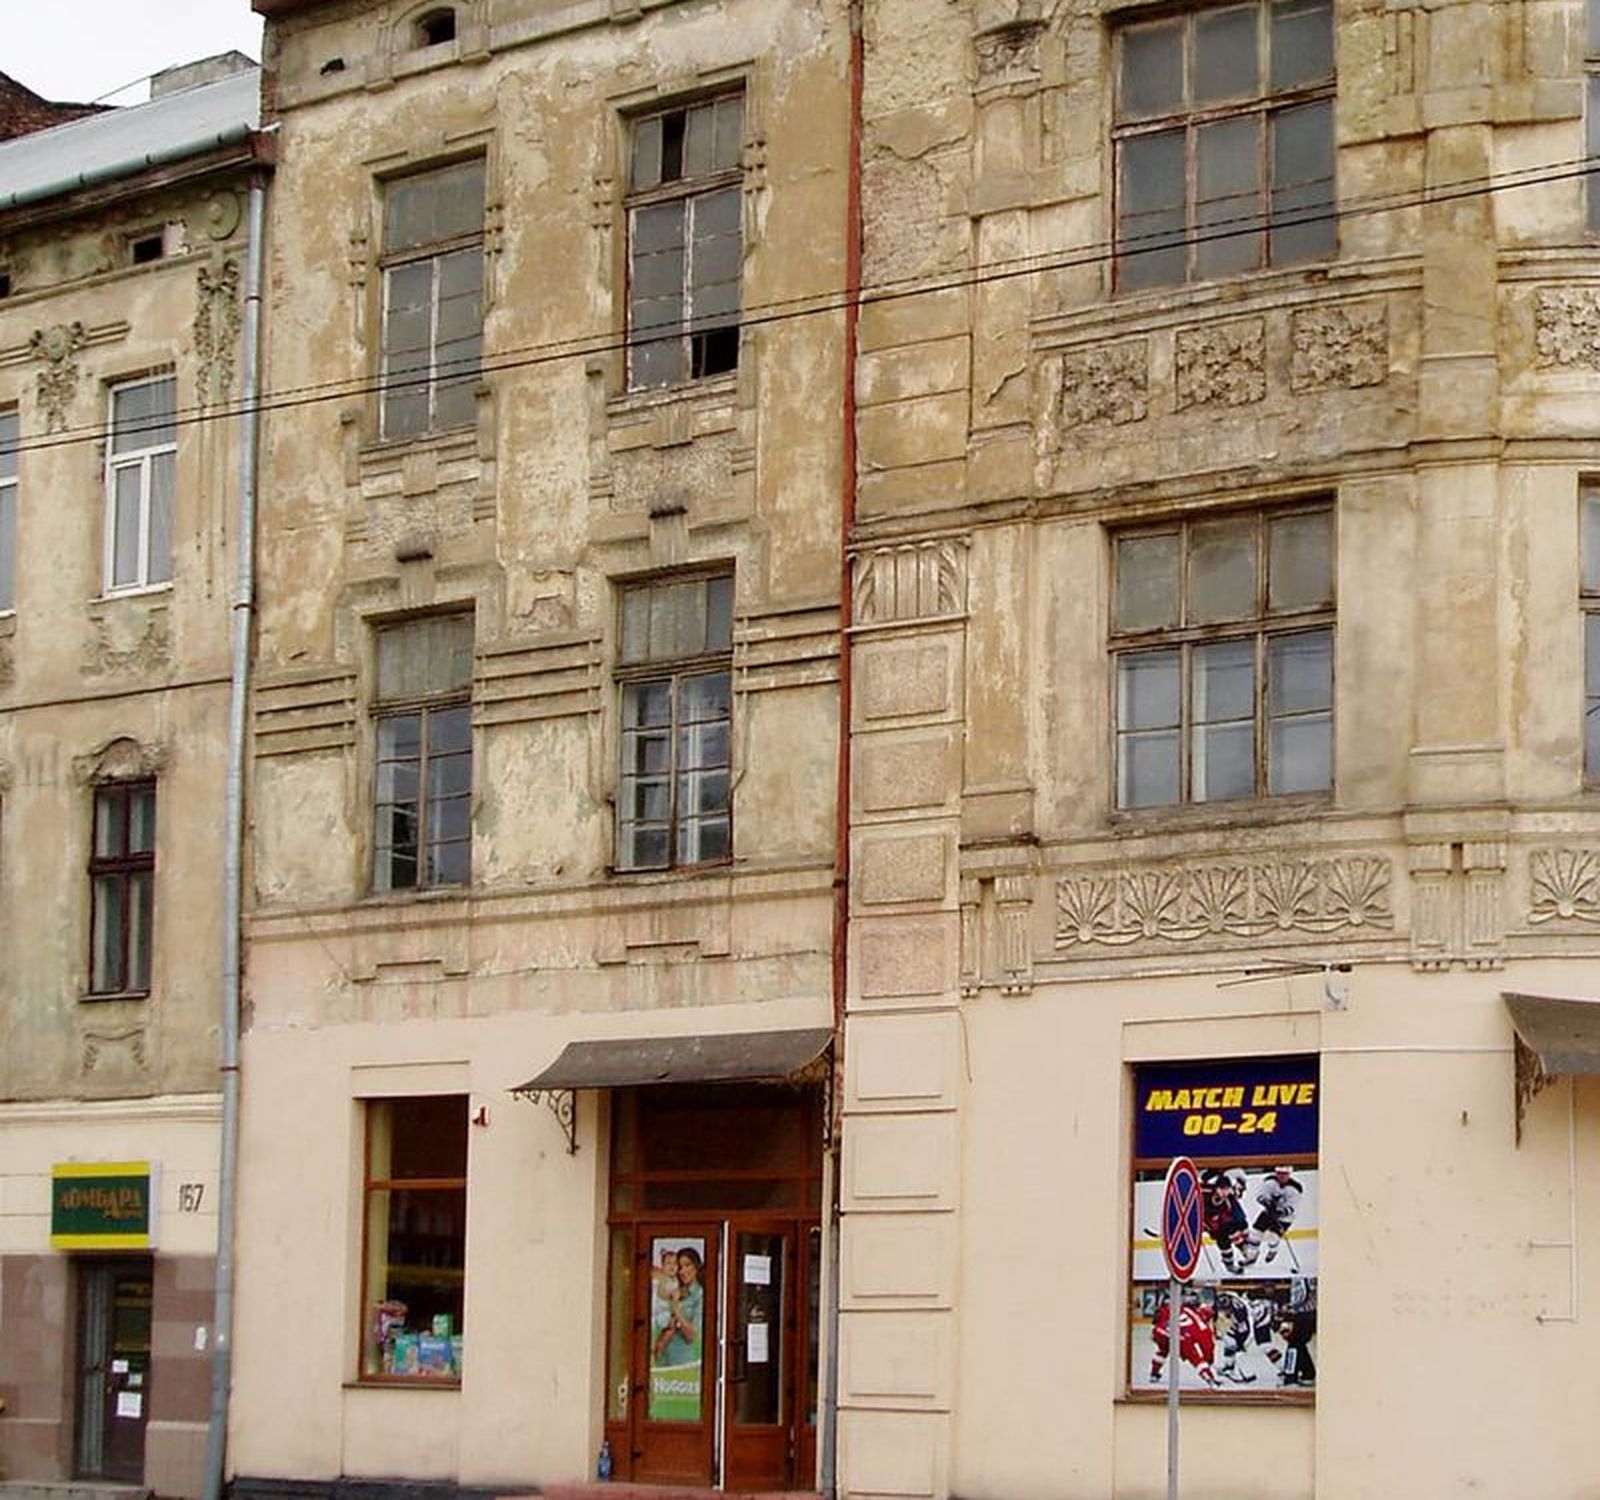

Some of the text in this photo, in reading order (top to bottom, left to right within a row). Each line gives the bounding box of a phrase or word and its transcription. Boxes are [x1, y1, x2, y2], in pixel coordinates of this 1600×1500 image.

[1145, 1083, 1315, 1111] MATCH LIVE
[1183, 1111, 1277, 1135] 00-24
[179, 1184, 204, 1212] 167
